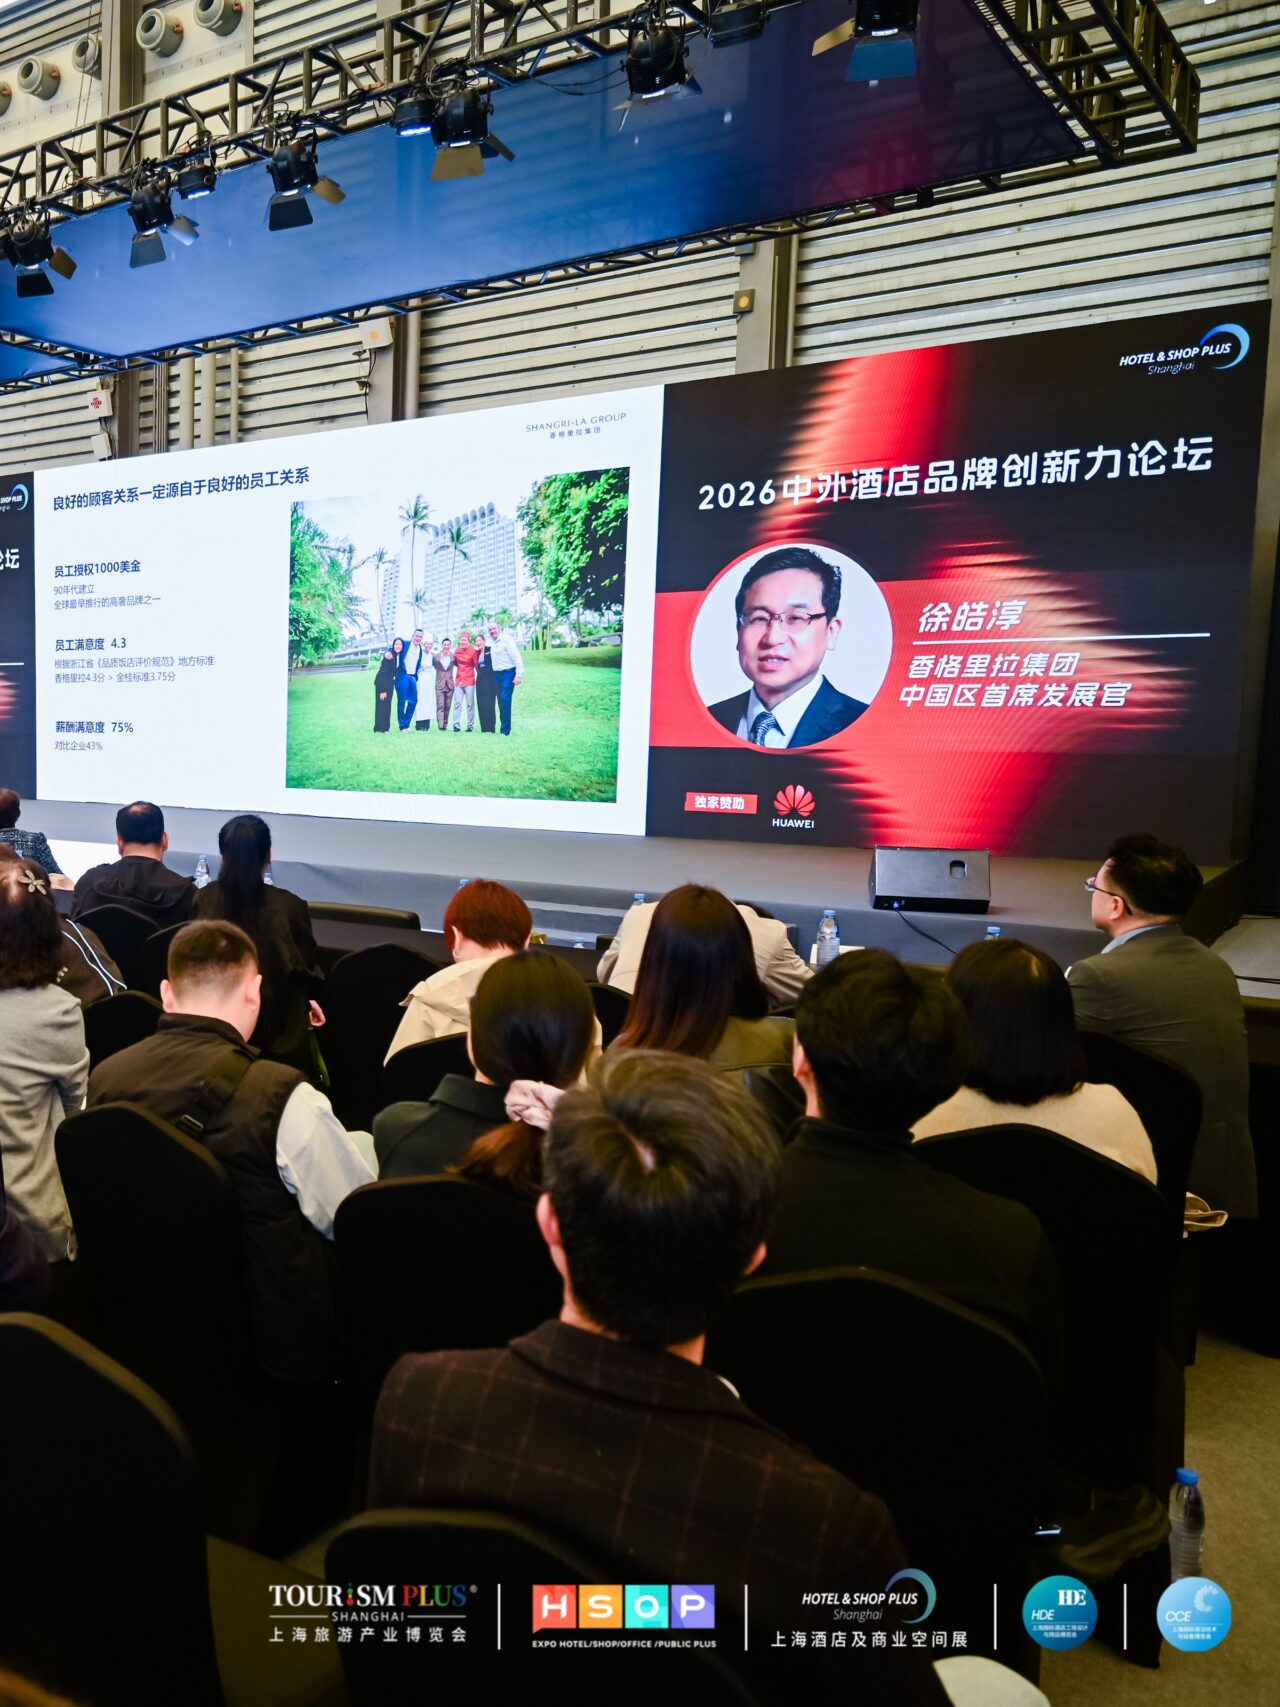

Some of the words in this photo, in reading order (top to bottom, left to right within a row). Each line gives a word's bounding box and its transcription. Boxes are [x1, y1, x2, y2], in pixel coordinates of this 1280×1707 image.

[1119, 352, 1155, 366] HOTEL
[1156, 351, 1166, 362] &
[1167, 346, 1200, 361] SHOP
[1201, 342, 1232, 356] PLUS
[1148, 361, 1195, 375] Shanghai
[525, 418, 587, 433] SHANGRI-LA
[590, 412, 627, 425] GROUP
[549, 426, 601, 439] 香格里拉集团
[698, 436, 1213, 510] 2026中外酒店品牌创新力论坛
[53, 466, 310, 511] 良好的顾客关系一定源自于良好的员工关系
[54, 559, 141, 578] 员工授权1000美金
[53, 584, 95, 595] 90年代建立
[918, 600, 1026, 633] 徐皓淳
[55, 638, 105, 652] 员工满意度
[110, 637, 127, 649] 4.3
[908, 652, 1080, 679] 香格里拉集团
[899, 682, 1132, 708] 中国区首席发展官
[55, 721, 105, 734] 薪酬满意度
[111, 722, 134, 733] 75%
[54, 740, 103, 751] 对比企业43%
[694, 795, 745, 810] 独家赞助
[772, 818, 815, 829] HUAWEI
